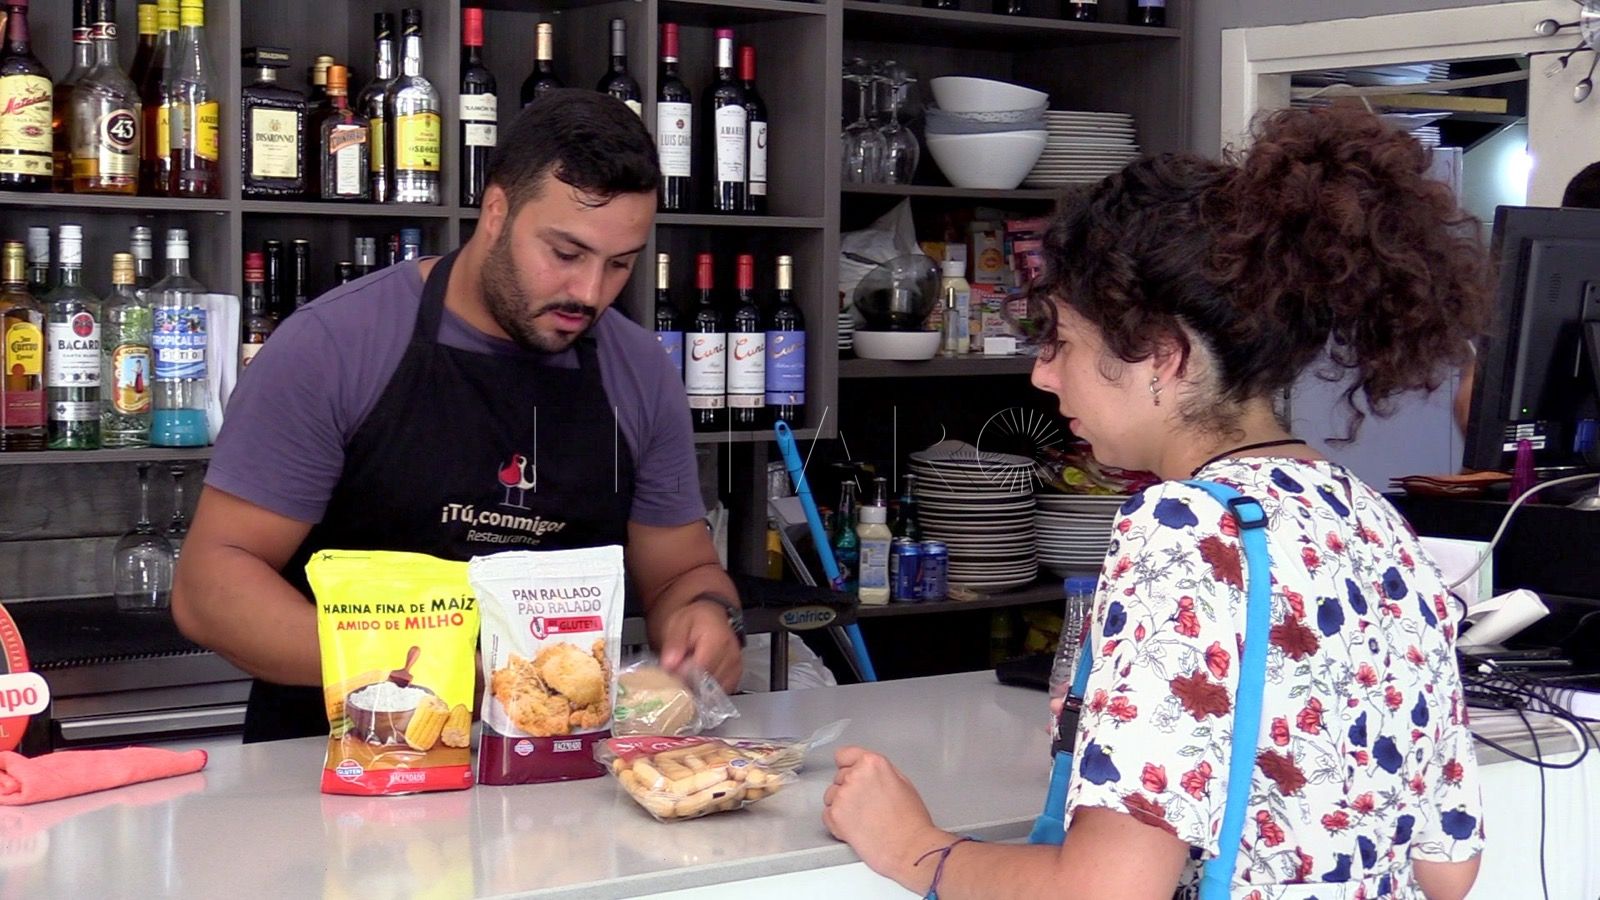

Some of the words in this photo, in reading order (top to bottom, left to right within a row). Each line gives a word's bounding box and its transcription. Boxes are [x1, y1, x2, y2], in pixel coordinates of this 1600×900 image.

[110, 119, 135, 138] 43
[255, 133, 295, 143] DISARONNO
[466, 529, 541, 546] Restaurante
[512, 589, 538, 600] PAN
[541, 586, 601, 600] RALLADO
[324, 603, 371, 614] HARINA
[376, 602, 405, 614] FINA
[410, 603, 425, 613] DE
[430, 594, 476, 612] MAÍZ
[549, 599, 601, 614] RALADO
[337, 620, 381, 631] AMIDO
[385, 620, 400, 630] DE
[404, 613, 464, 630] MILHO
[559, 619, 598, 631] GLUTEN
